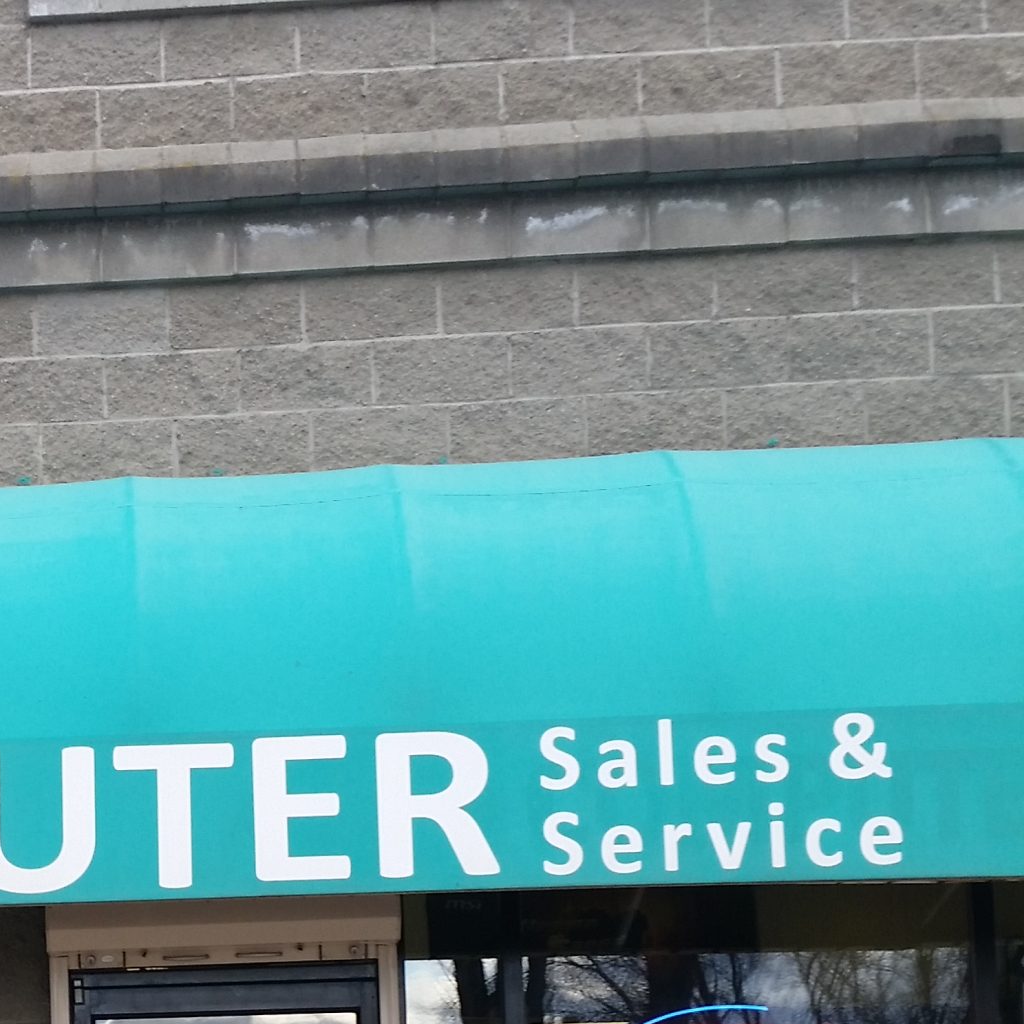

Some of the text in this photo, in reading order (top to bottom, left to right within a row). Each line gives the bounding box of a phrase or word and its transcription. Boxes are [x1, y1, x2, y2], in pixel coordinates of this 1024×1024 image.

[539, 712, 893, 790] Sales &
[542, 802, 903, 876] Service
